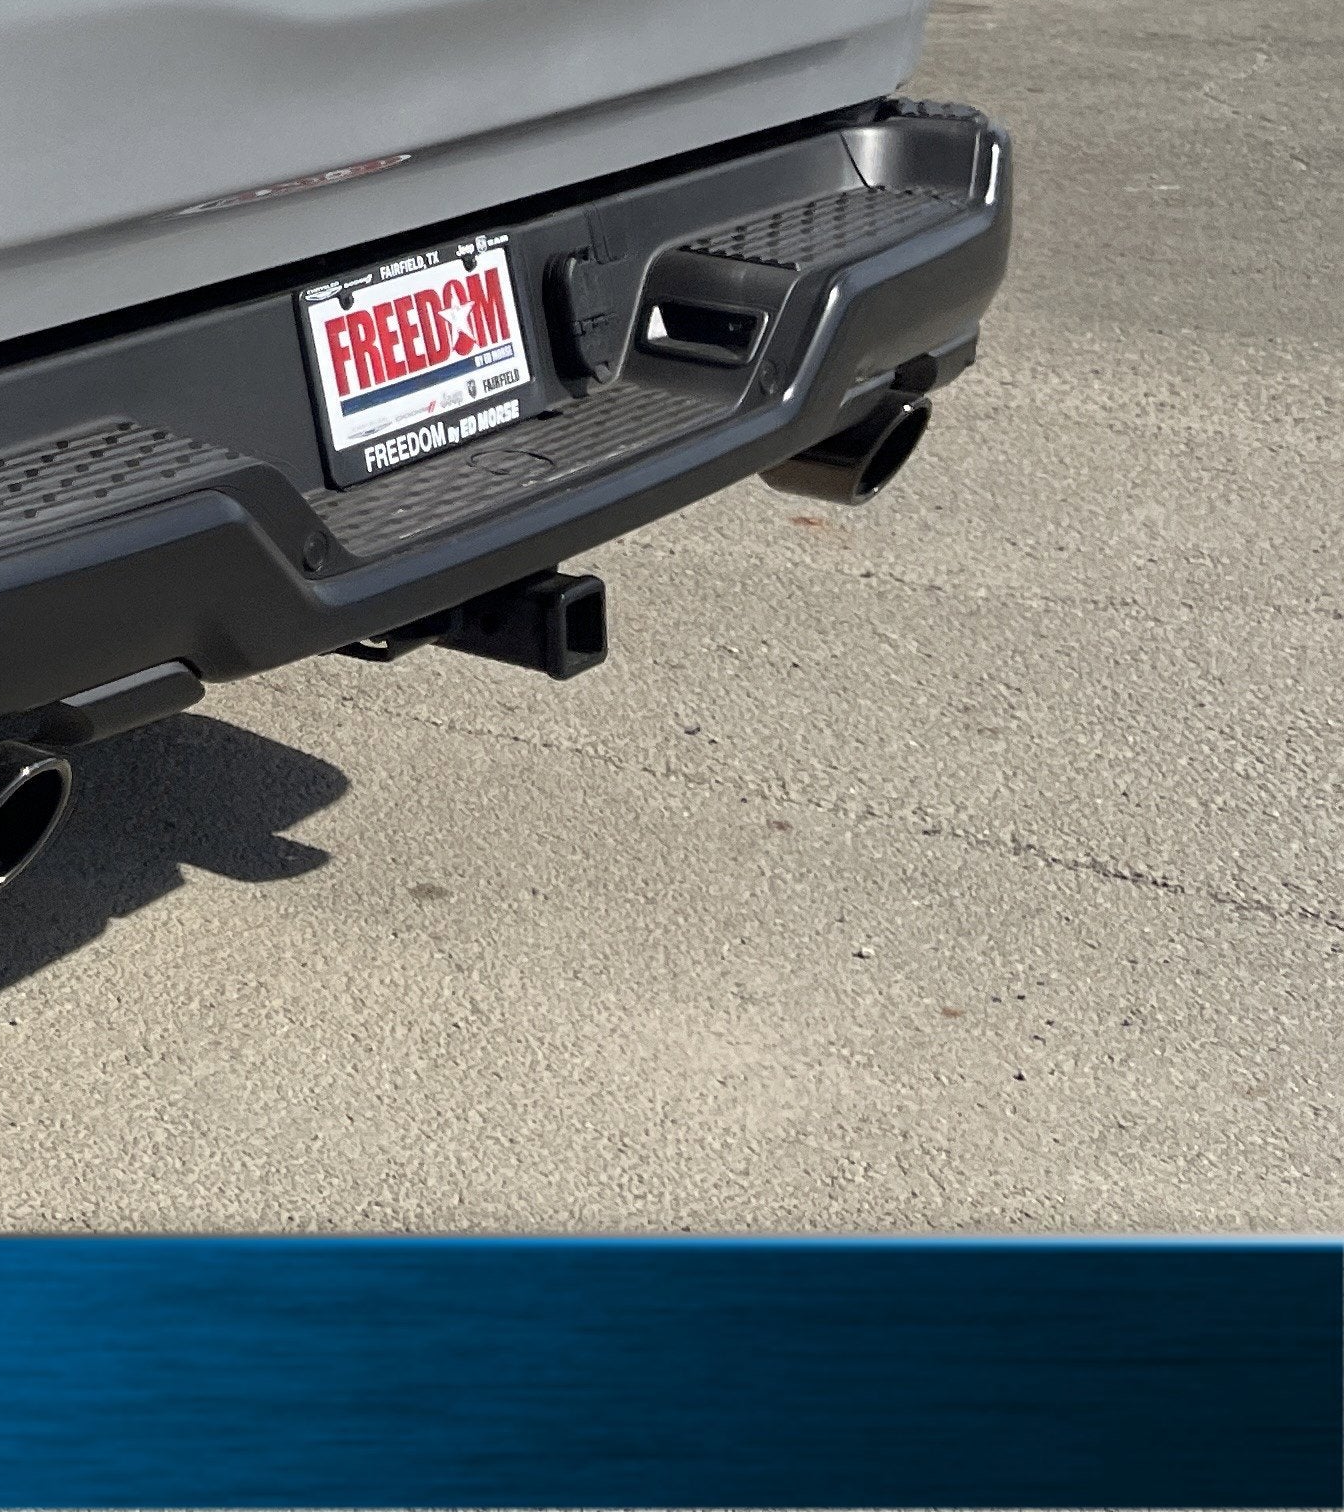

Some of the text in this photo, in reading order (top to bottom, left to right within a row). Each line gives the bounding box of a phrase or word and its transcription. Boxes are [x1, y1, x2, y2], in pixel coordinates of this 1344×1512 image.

[379, 250, 440, 280] FAIRFIELD, TX
[324, 267, 511, 397] FREEDOM
[482, 368, 520, 393] FAIRFIELD
[365, 421, 447, 473] FREEDOM
[460, 417, 478, 440] ED
[477, 399, 520, 432] MORSE
